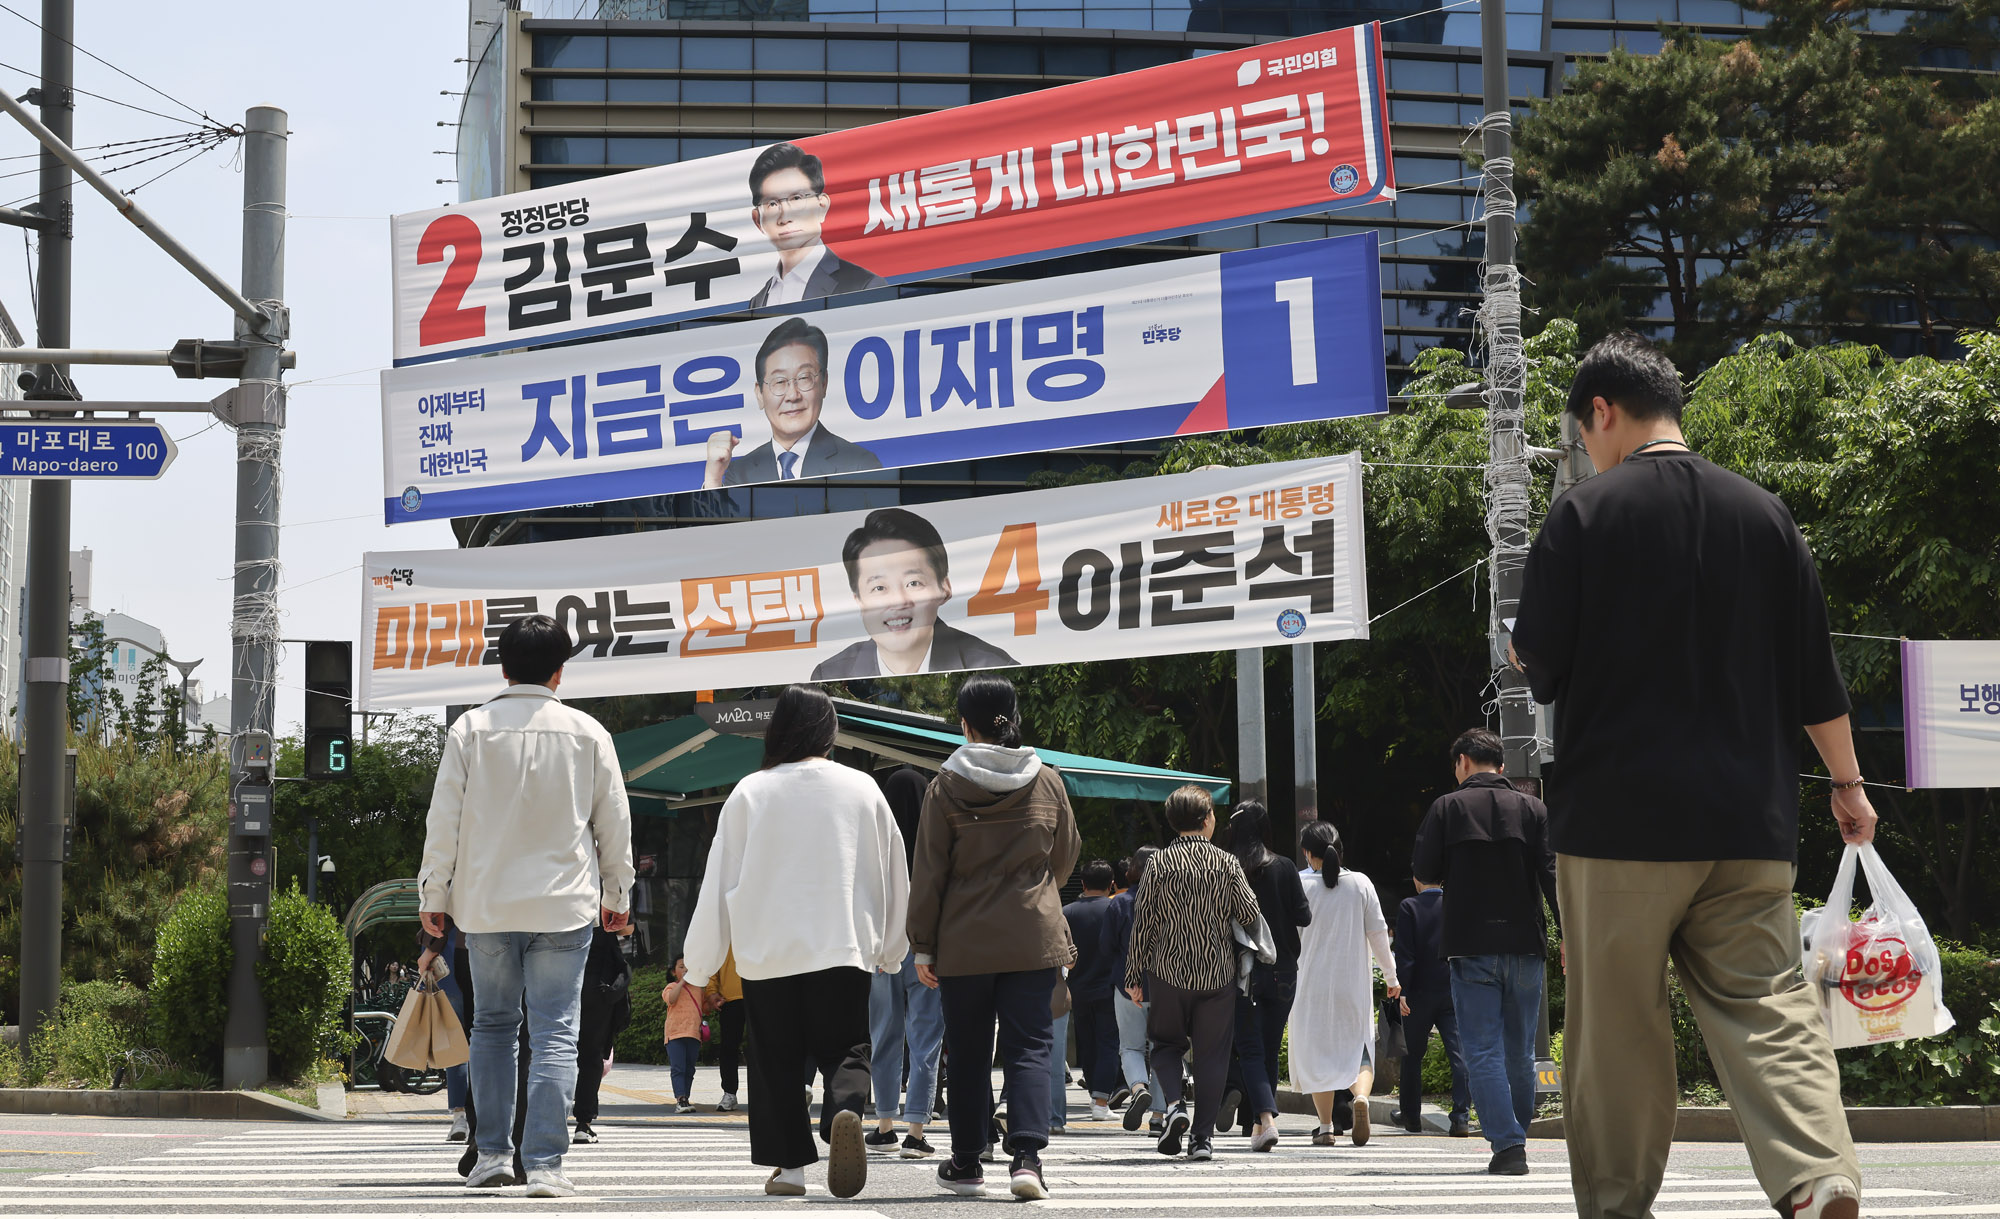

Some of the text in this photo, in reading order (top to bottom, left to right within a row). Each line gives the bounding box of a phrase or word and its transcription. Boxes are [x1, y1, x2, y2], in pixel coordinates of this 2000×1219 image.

[1267, 47, 1338, 77] 국민의힘
[863, 92, 1330, 235] 새롭게 대한민국!
[501, 198, 590, 238] 정정당당
[416, 213, 486, 347] 2
[502, 212, 741, 330] 김문수
[1142, 327, 1181, 344] 민주당
[1275, 277, 1318, 386] 1
[843, 304, 1107, 421] 이재명
[418, 388, 485, 417] 이제부터
[521, 355, 745, 463] 지금은
[17, 429, 115, 453] 마포대로
[125, 443, 158, 460] 100
[419, 422, 453, 448] 진짜
[12, 457, 118, 474] Mapo-daero
[420, 449, 488, 478] 대한민국
[1156, 482, 1336, 533] 새로운 대통령
[966, 519, 1335, 636] 4 이준석
[553, 589, 676, 659] 여는
[686, 573, 820, 652] 선택
[329, 740, 345, 771] 6
